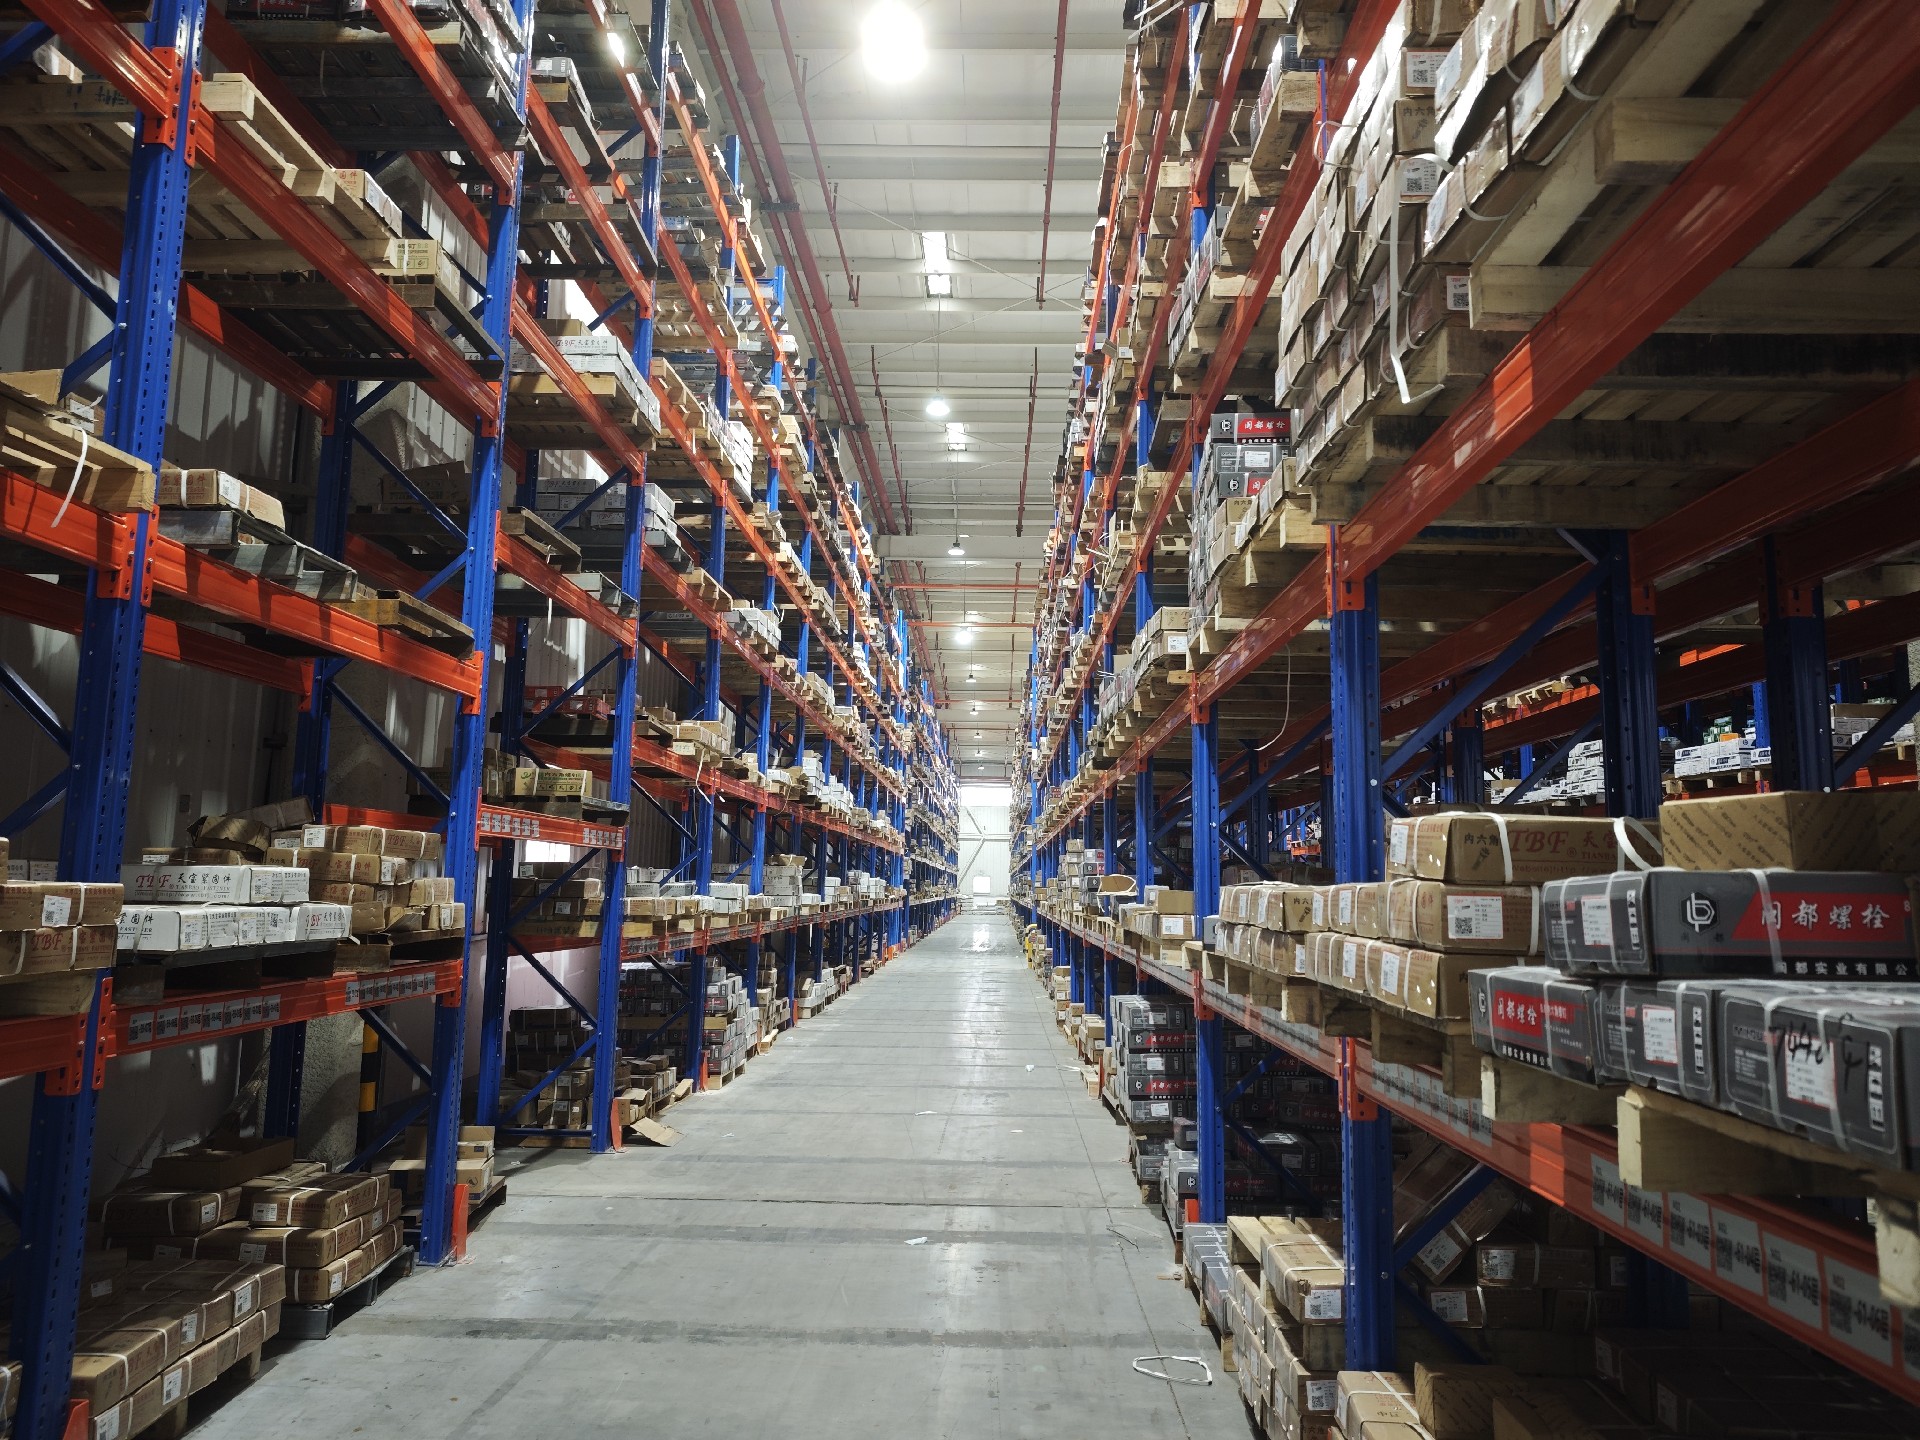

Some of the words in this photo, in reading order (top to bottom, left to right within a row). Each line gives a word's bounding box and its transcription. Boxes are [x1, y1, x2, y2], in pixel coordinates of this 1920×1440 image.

[1463, 833, 1500, 847] 内六角
[1507, 829, 1569, 854] TBF
[177, 872, 232, 885] 天宝紧固件
[1293, 896, 1313, 905] 内六
